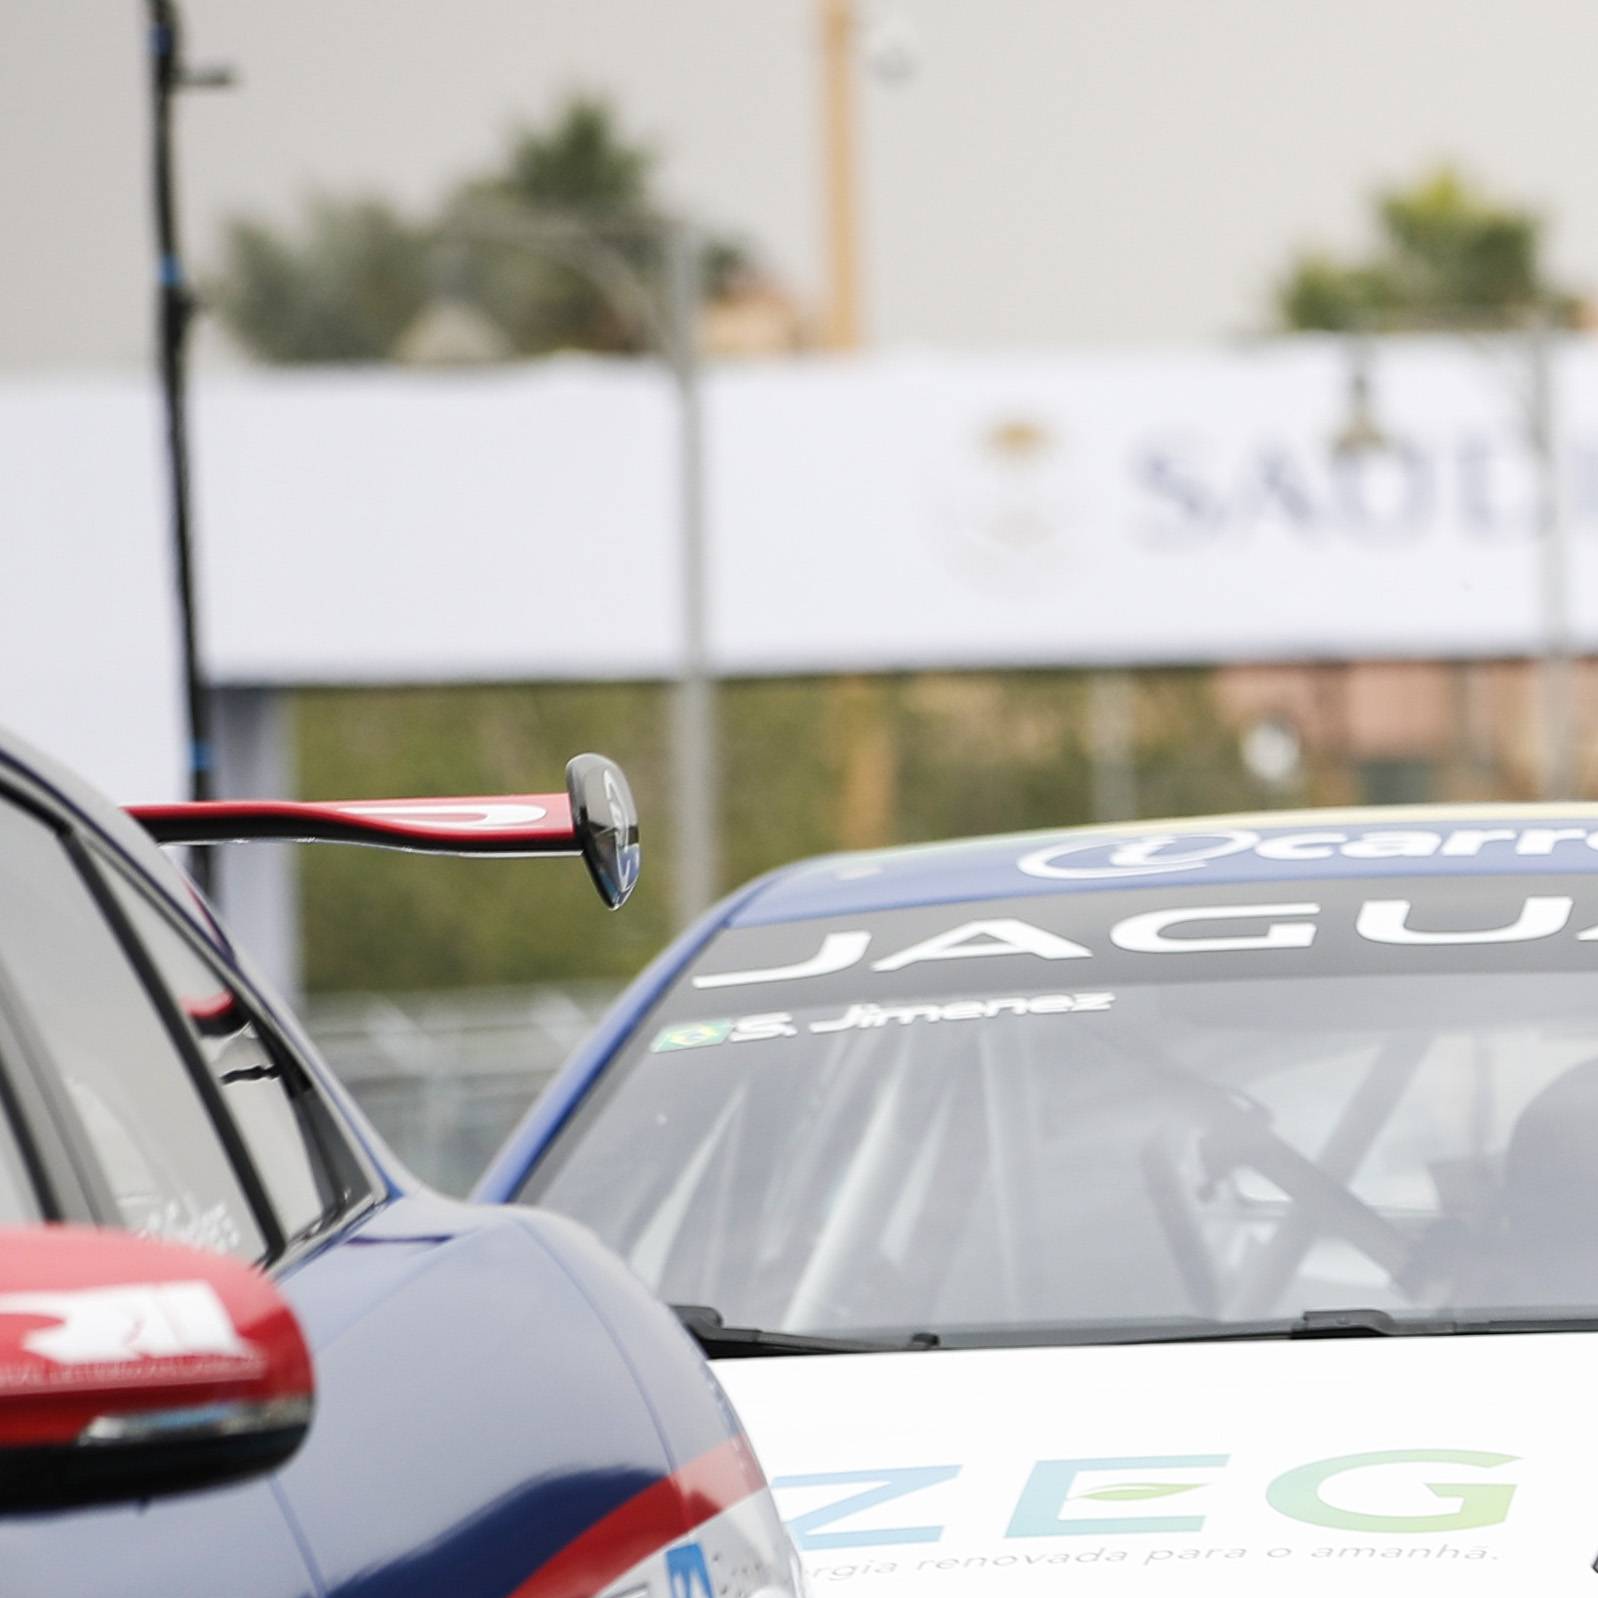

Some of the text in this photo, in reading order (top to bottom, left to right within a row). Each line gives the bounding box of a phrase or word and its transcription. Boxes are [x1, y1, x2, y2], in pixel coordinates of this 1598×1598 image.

[730, 992, 1116, 1042] S. Jimenez
[772, 1448, 1524, 1551] ZEG
[803, 1560, 897, 1582] rgia
[916, 1548, 1128, 1572] renovada
[1144, 1546, 1247, 1566] para
[1266, 1546, 1293, 1560] o
